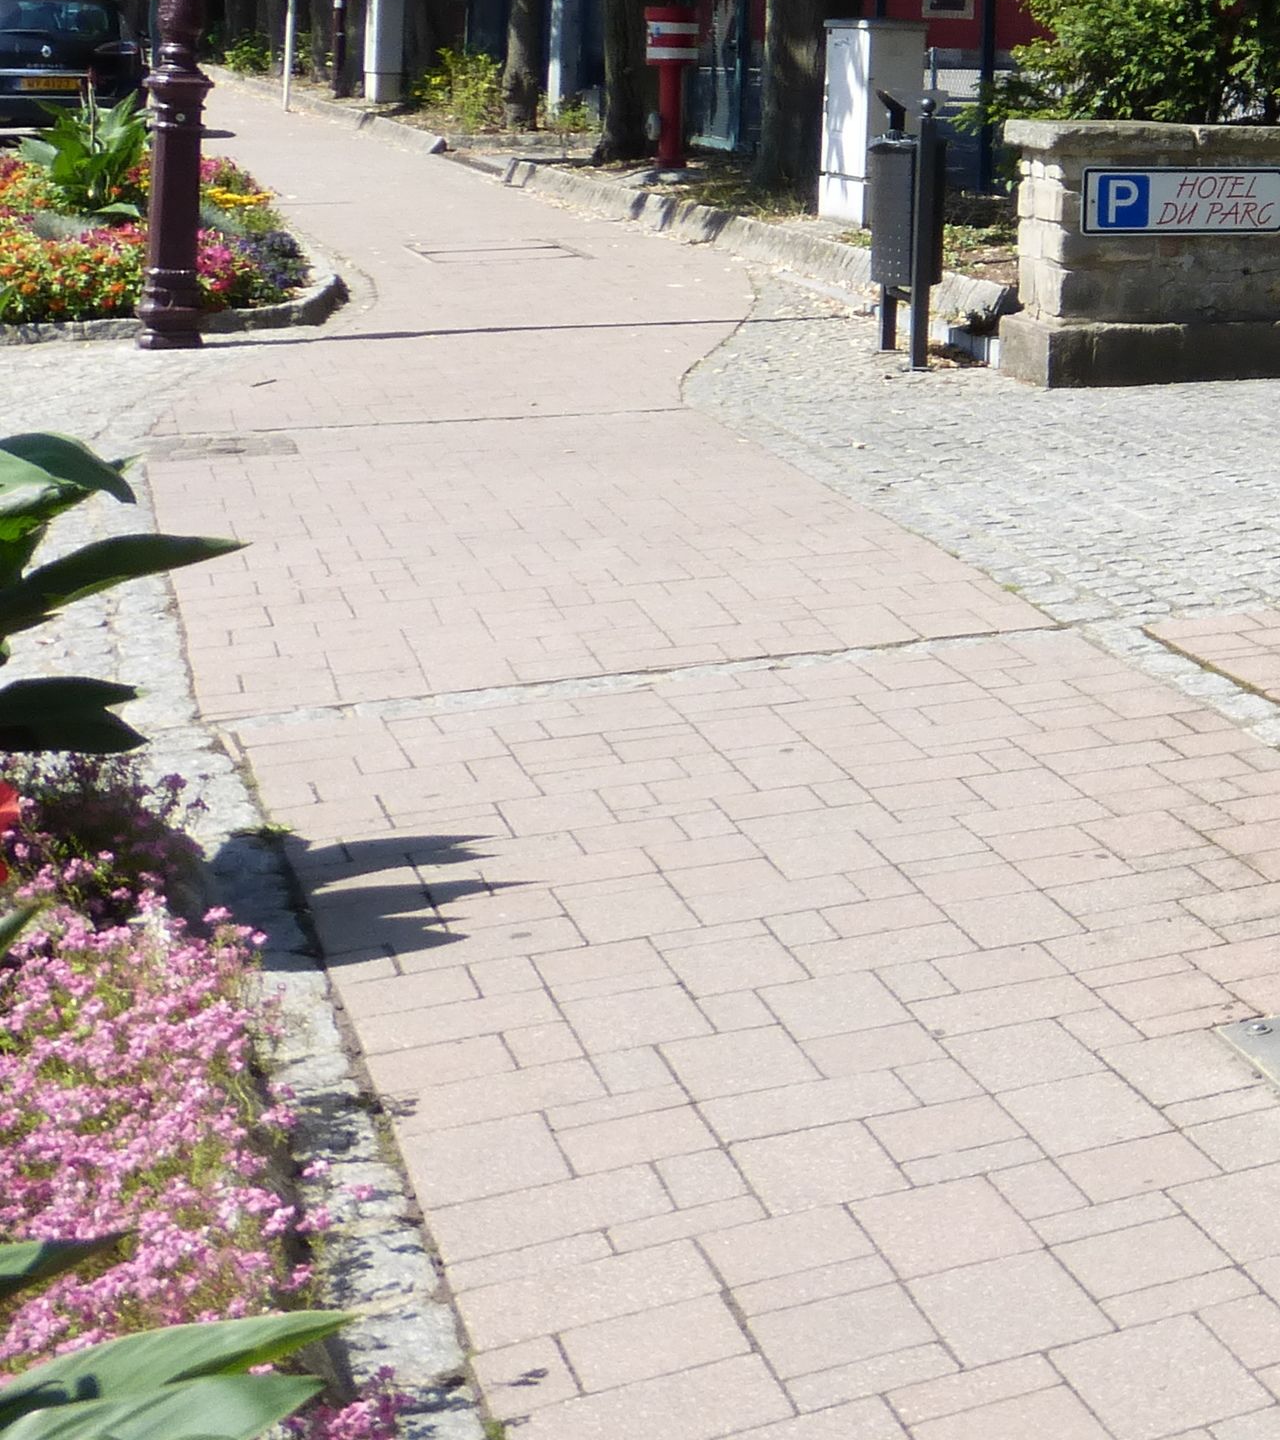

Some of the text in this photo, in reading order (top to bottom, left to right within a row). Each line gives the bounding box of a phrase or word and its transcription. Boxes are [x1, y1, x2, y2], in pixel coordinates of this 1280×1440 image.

[1176, 176, 1258, 200] HOTEL
[1107, 179, 1140, 224] P
[1156, 202, 1275, 228] DU PARC
